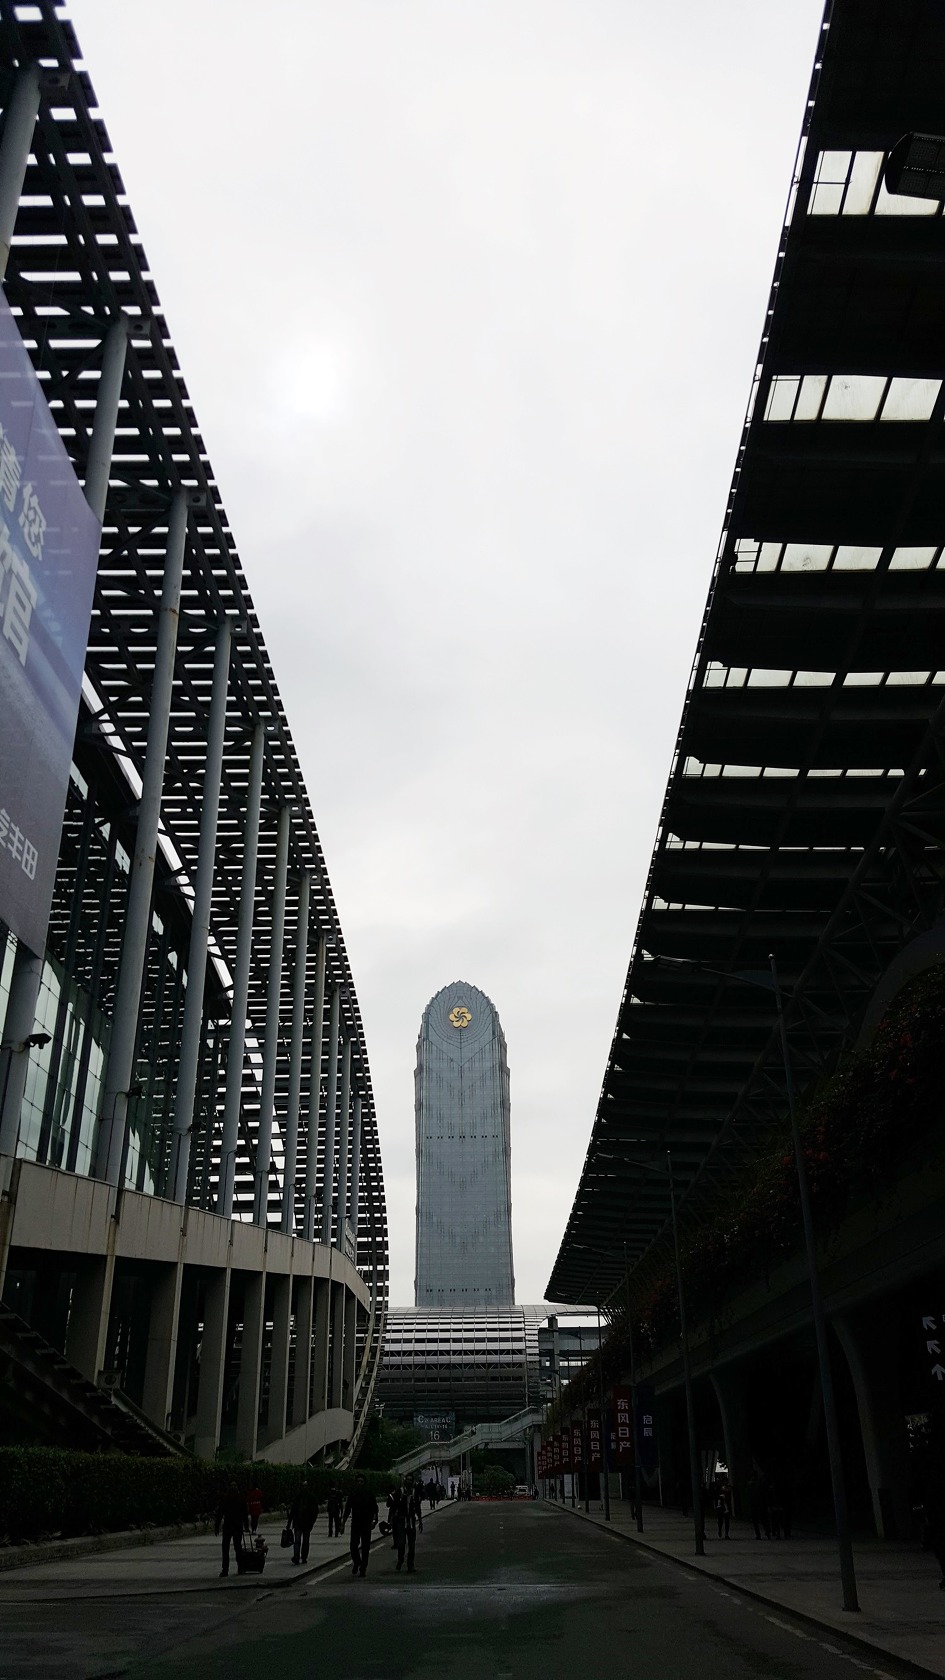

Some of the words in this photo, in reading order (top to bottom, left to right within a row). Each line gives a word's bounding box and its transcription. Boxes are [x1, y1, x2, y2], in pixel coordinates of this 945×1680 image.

[430, 1430, 440, 1440] 16
[590, 1419, 601, 1462] 东风日产
[617, 1398, 631, 1453] 东风日产
[643, 1414, 653, 1437] 启辰
[573, 1429, 583, 1464] 东风日产
